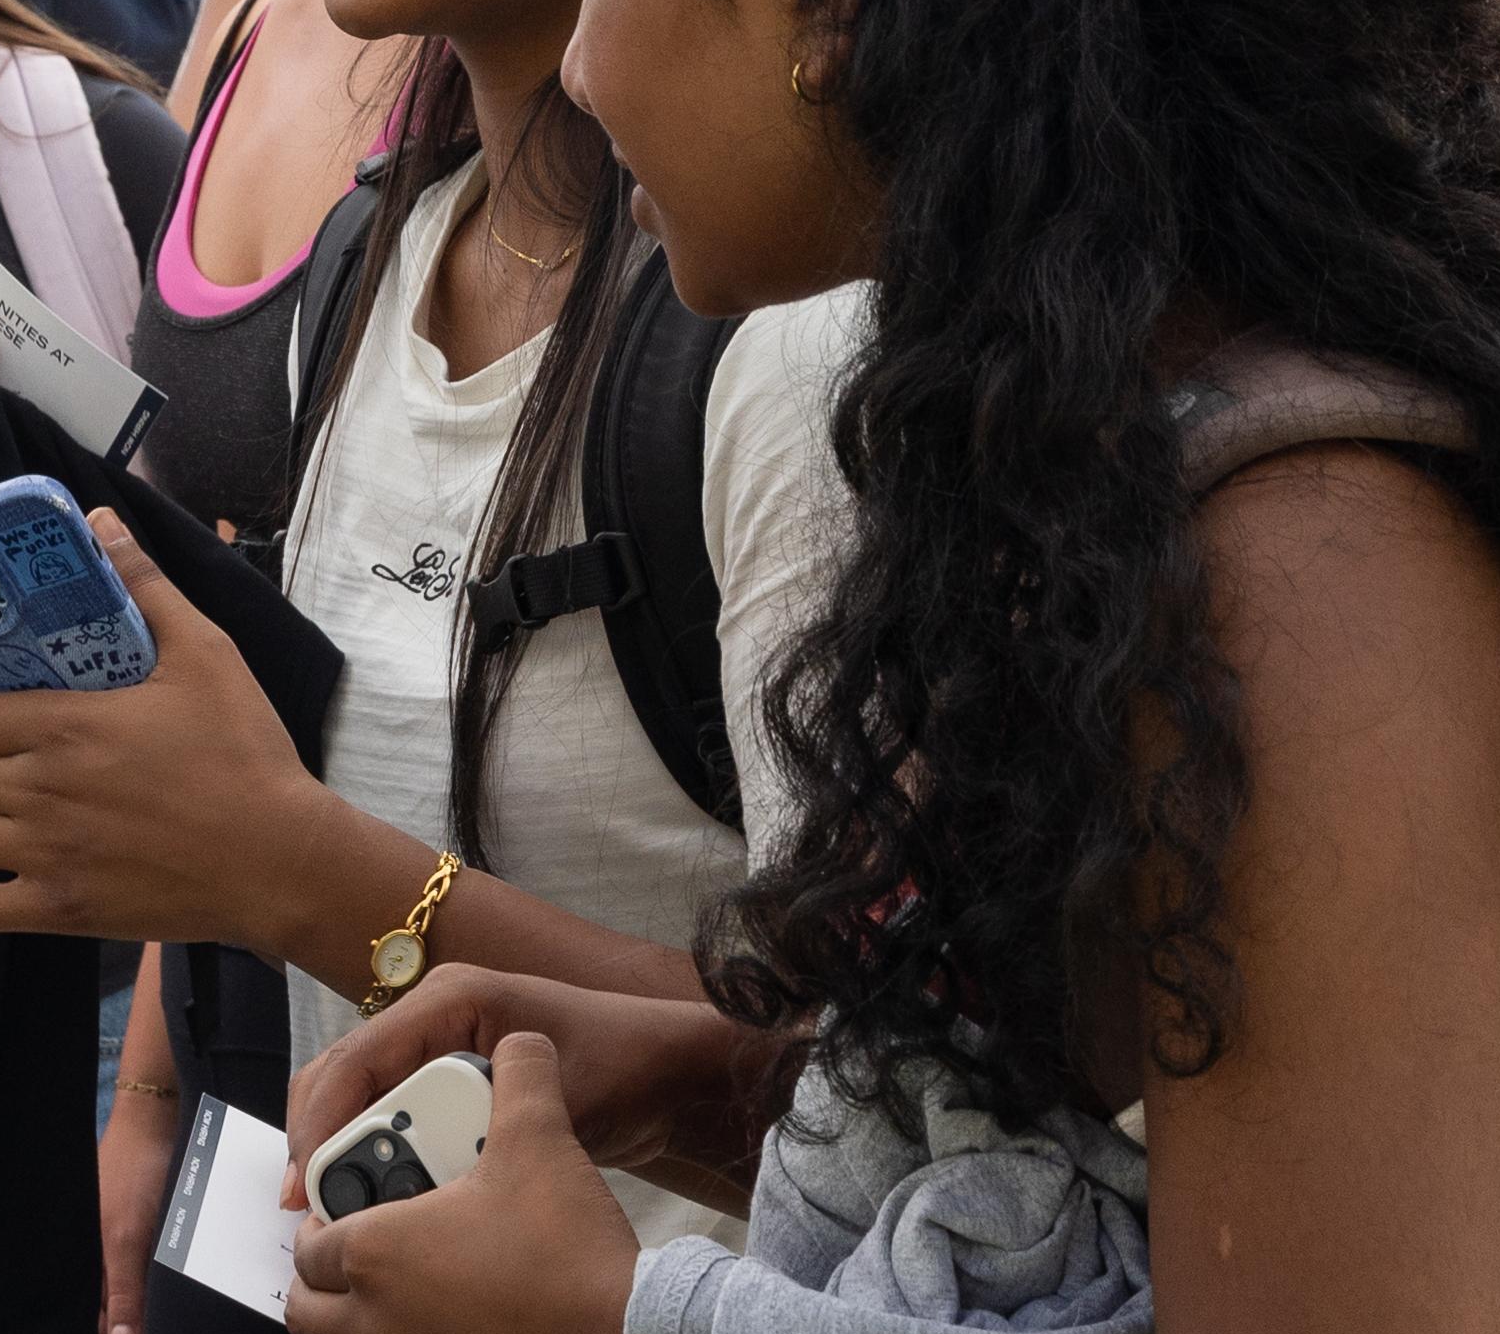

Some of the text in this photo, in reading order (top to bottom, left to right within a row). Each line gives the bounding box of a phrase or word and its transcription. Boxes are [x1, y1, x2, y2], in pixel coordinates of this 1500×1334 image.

[50, 349, 75, 367] AT
[68, 650, 120, 677] LIFE
[197, 1109, 213, 1146] NOW HIRING
[184, 1156, 201, 1196] NOW HIRING
[168, 1207, 187, 1249] NOW HIRING
